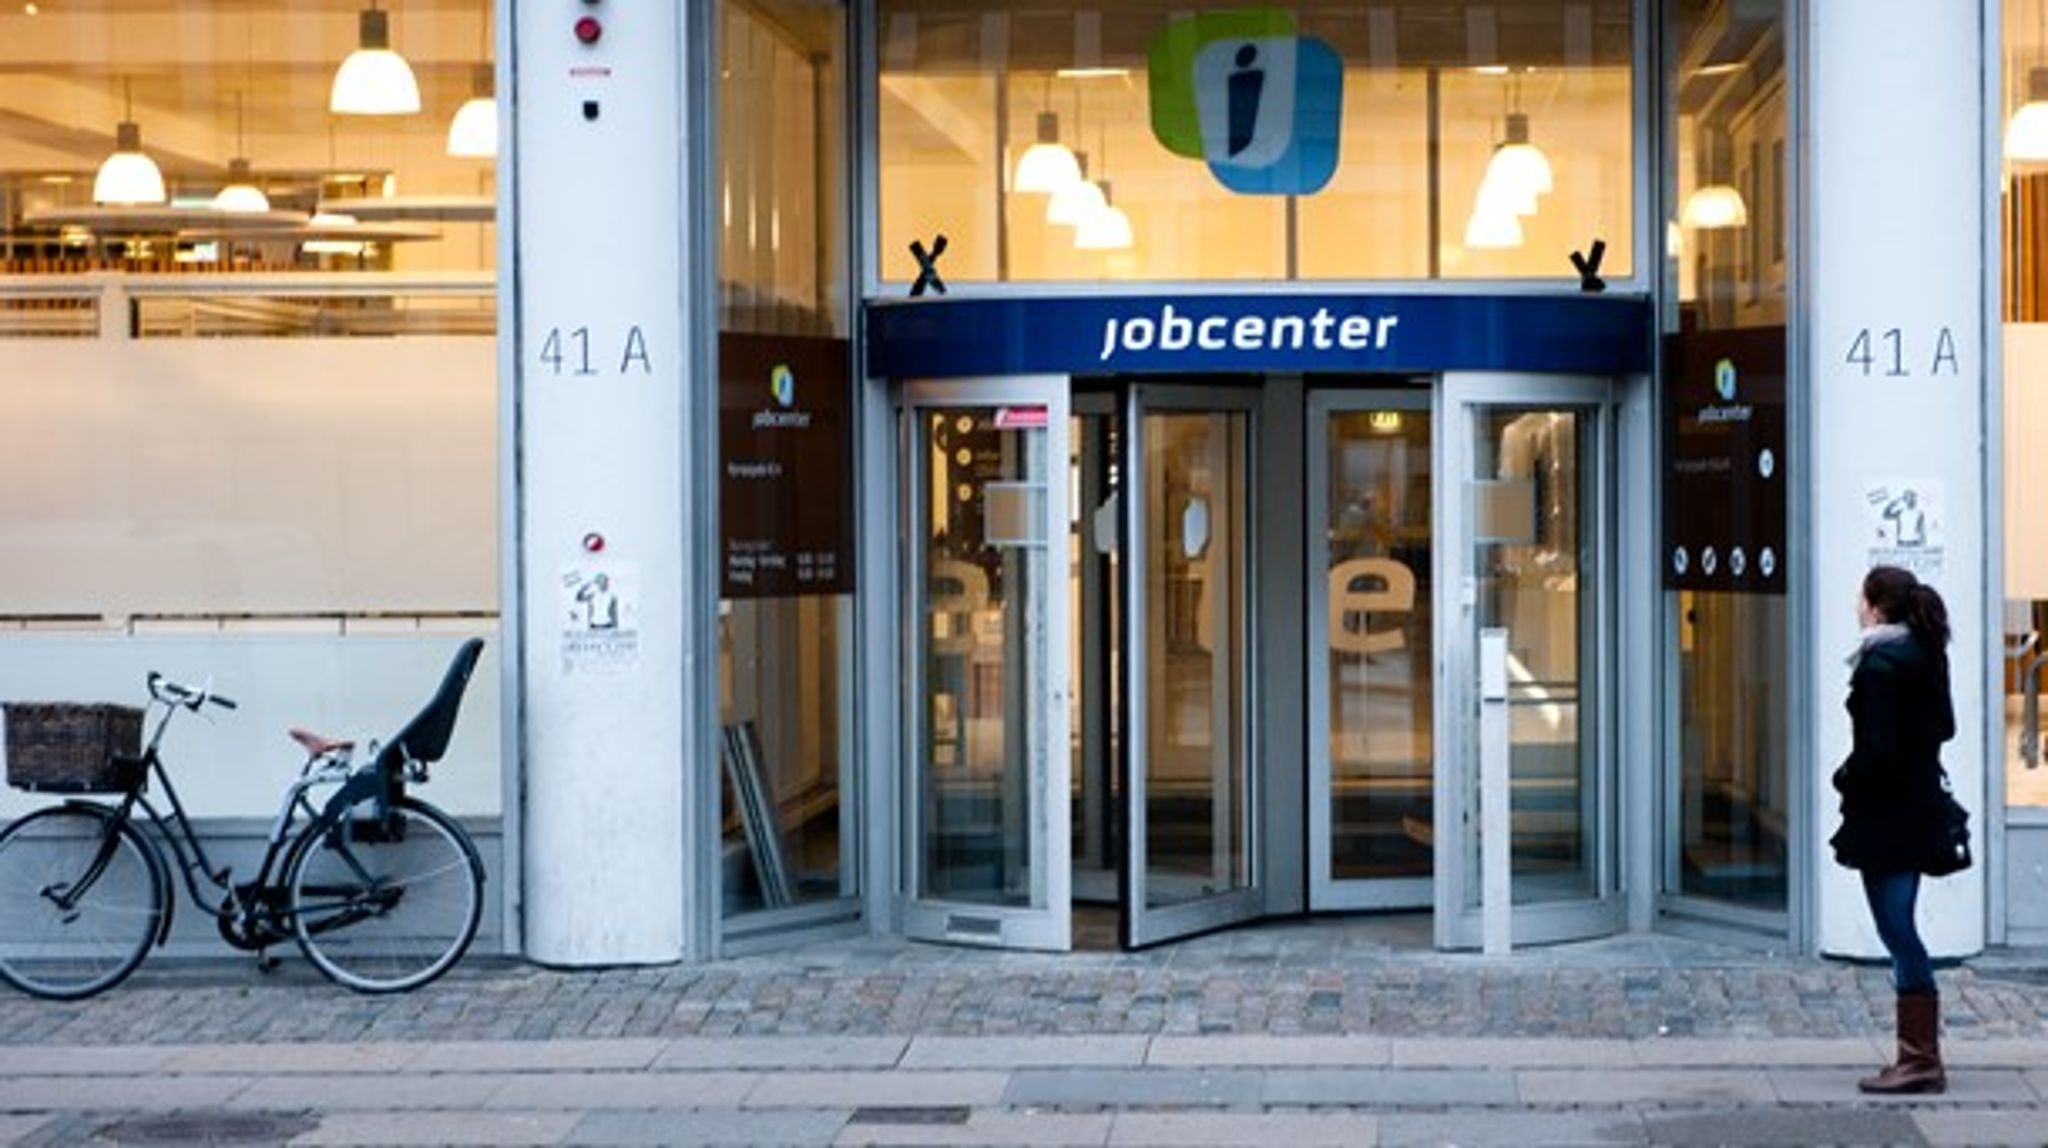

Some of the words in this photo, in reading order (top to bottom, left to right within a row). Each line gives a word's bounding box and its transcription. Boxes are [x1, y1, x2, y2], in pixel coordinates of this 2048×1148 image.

[540, 327, 599, 375] 41
[620, 325, 652, 374] A
[1100, 304, 1398, 360] jobcenter
[1846, 328, 1911, 377] 41
[1931, 326, 1959, 375] A
